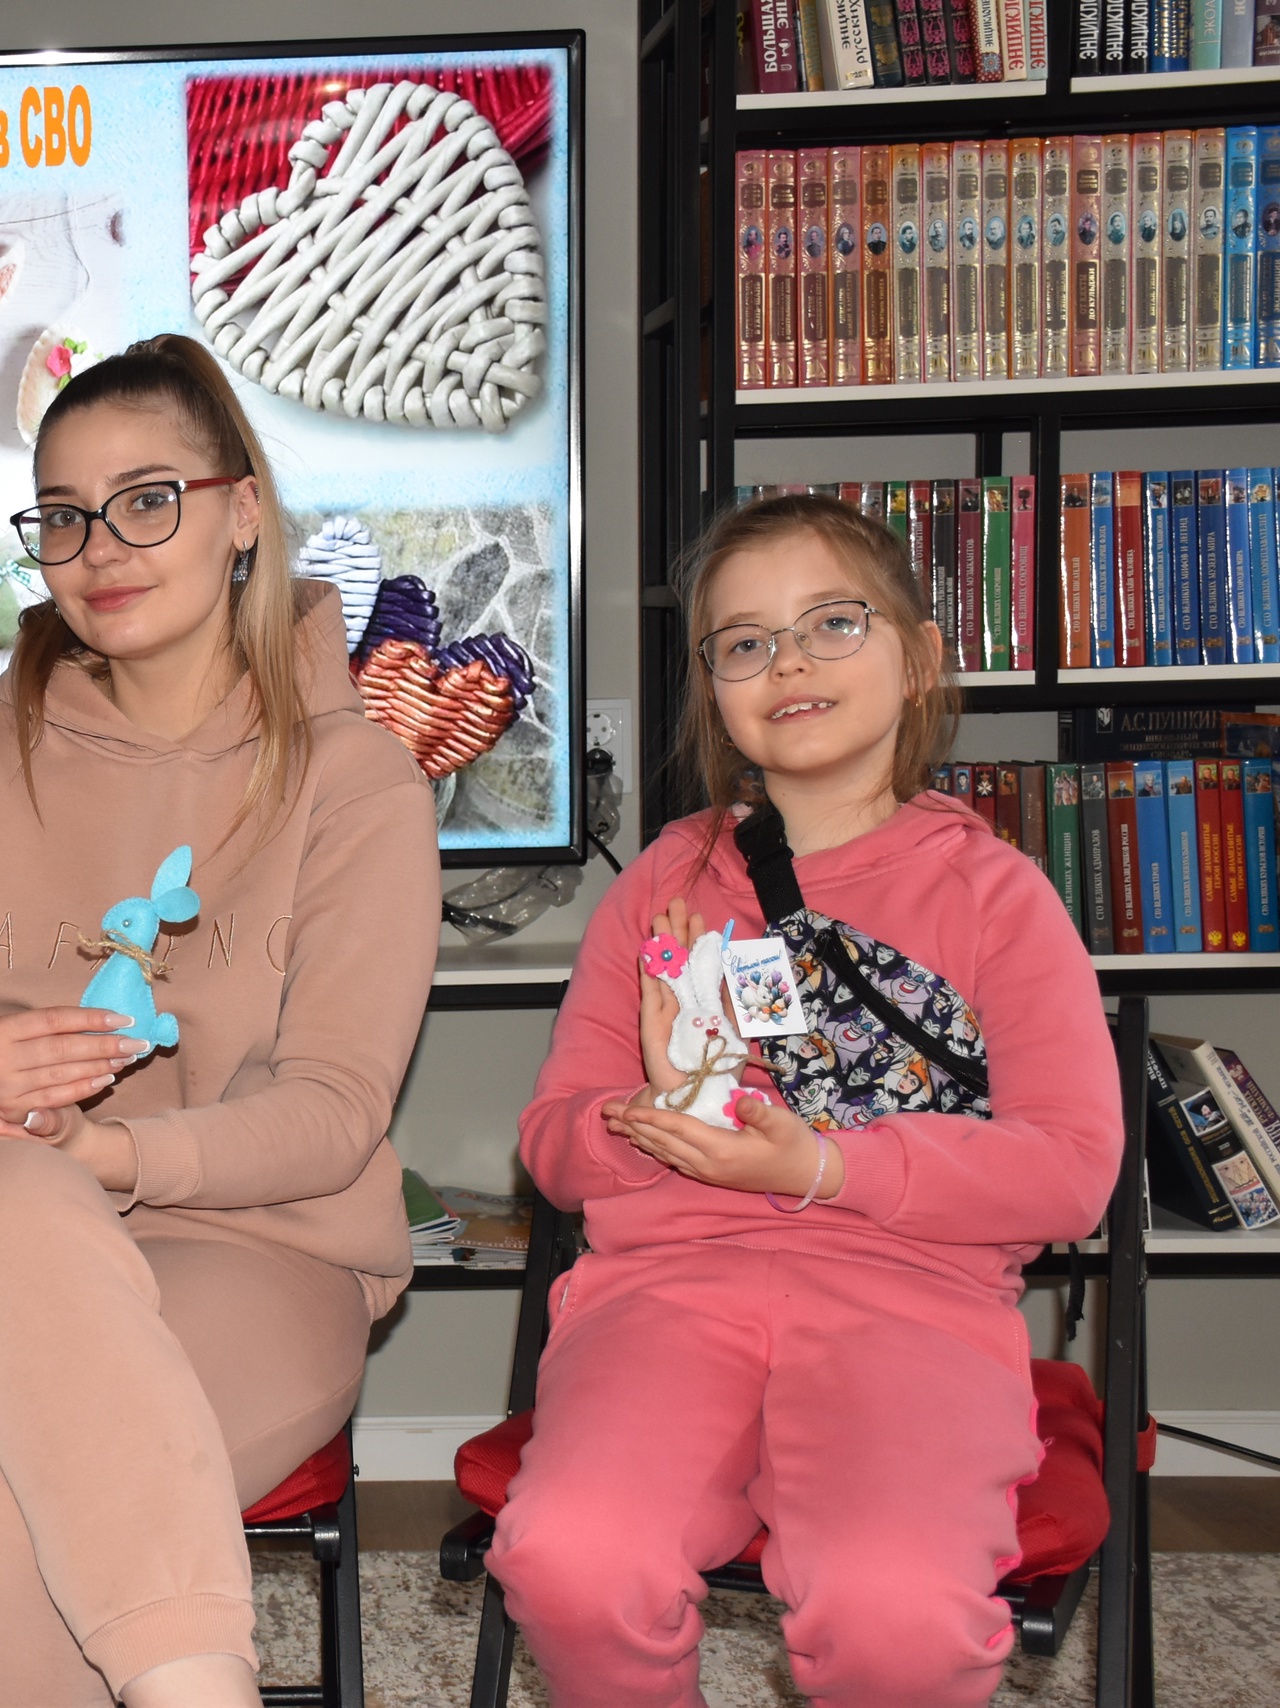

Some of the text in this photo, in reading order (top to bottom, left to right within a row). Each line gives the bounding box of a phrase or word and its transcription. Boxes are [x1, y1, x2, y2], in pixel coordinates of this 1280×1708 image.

[761, 0, 778, 73] БОЛЬША
[1005, 0, 1025, 71] ЭНЦИКЛ
[20, 85, 92, 168] СВО
[1088, 267, 1096, 321] ДО КУЛЬДЖИ
[1179, 517, 1189, 544] ЛЕГЕНД
[1071, 557, 1080, 591] ПИСАТЕЛЕЙ
[1126, 549, 1134, 577] ЧЕЛОВЕКА
[1180, 553, 1189, 580] МИФОВ
[1207, 531, 1218, 630] СТО ВЕЛИКИХ МУЗЕЕВ МИРА
[1258, 513, 1272, 627] СТО ВЕЛИКИХ МОРЕПЛАВАТЕЛЕЙ
[965, 538, 974, 637] СТО ВЕЛИКИХ МУЗЫКАНТОВ
[1018, 545, 1028, 636] СТО ВЕЛИКИХ СОКРОВИЩ
[1181, 581, 1190, 614] ВЕЛИКИХ
[1072, 620, 1081, 633] СТО
[1127, 619, 1135, 630] СТО
[1182, 615, 1191, 631] СТО
[1238, 617, 1246, 629] СТО
[1062, 832, 1072, 868] ЖЕНЩИН
[1203, 822, 1213, 902] САМЫЕ ЗНАМЕНИТЫЕ
[1212, 833, 1221, 889] ГЕРОИ РОССИИ
[1226, 822, 1238, 903] САМЫЕ ЗНАМЕНИТЫЕ
[1235, 834, 1245, 890] ГЕРОИ РОССИИ
[1064, 869, 1073, 904] ВЕЛИКИХ
[1091, 829, 1105, 921] СТО ВЕЛИКИХ АДМИРАЛОВ
[1126, 909, 1134, 920] СТО
[1154, 908, 1162, 919] СТО
